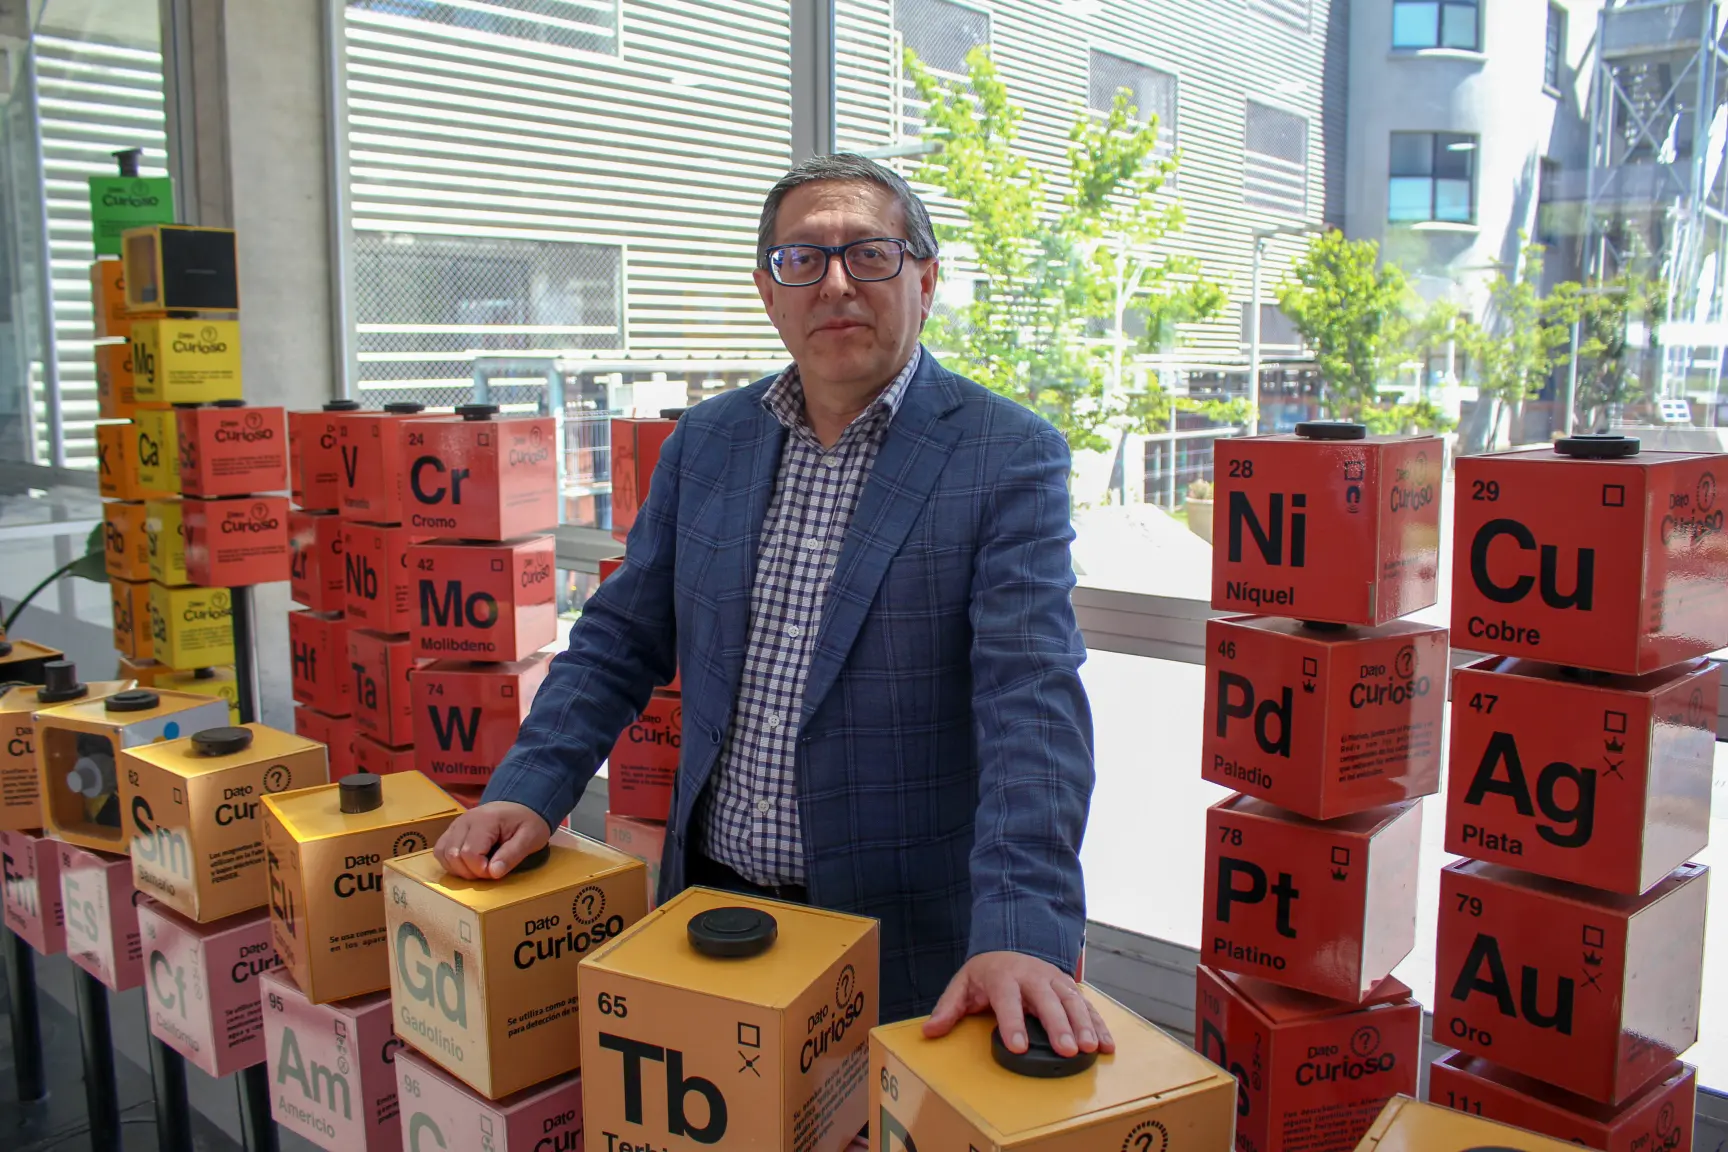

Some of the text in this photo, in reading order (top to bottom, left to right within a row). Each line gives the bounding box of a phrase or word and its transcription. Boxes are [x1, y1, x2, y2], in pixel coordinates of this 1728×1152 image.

[102, 194, 160, 208] Curioso
[172, 340, 228, 355] Curioso
[133, 342, 155, 383] Mg
[139, 432, 159, 467] Ca
[214, 427, 273, 443] Curioso
[408, 433, 425, 446] 24
[341, 445, 358, 488] V
[509, 447, 548, 466] Curioso
[1229, 460, 1254, 478] 28
[410, 455, 470, 506] Cr
[1472, 480, 1500, 501] 29
[1390, 484, 1433, 513] Curioso
[1669, 493, 1690, 509] Dato
[221, 517, 279, 535] Curioso
[412, 514, 457, 529] Cromo
[1228, 491, 1307, 568] Ni
[345, 552, 377, 600] Nb
[417, 558, 434, 571] 42
[1470, 518, 1595, 612] Cu
[419, 579, 499, 629] Mo
[1226, 581, 1295, 607] Níquel
[421, 636, 496, 653] Molibdeno
[1468, 616, 1540, 645] Cobre
[292, 638, 316, 684] Hf
[1218, 640, 1236, 660] 46
[351, 661, 377, 711] Ta
[1360, 664, 1386, 679] Dato
[426, 683, 444, 696] 74
[1349, 675, 1431, 709] Curioso
[1469, 693, 1499, 715] 47
[427, 705, 482, 752] W
[1216, 670, 1294, 759] Pd
[628, 724, 681, 748] Curio
[128, 769, 140, 787] 62
[1214, 754, 1272, 790] Paladio
[223, 783, 253, 800] Dato
[1464, 731, 1597, 849] Ag
[131, 795, 190, 880] Sm
[612, 828, 632, 844] 109
[1218, 826, 1243, 846] 78
[1462, 824, 1523, 857] Plata
[344, 853, 381, 870] Dato
[137, 864, 176, 897] Samario
[65, 876, 98, 943] Es
[392, 885, 408, 908] 64
[1216, 855, 1299, 939] Pt
[1456, 893, 1483, 918] 79
[525, 914, 560, 936] Dato
[239, 940, 268, 958] Dato
[362, 936, 386, 946] apara
[513, 913, 625, 970] Curioso
[1213, 937, 1287, 970] Platino
[150, 949, 187, 1020] Cf
[396, 921, 468, 1030] Gd
[1450, 932, 1575, 1036] Au
[268, 992, 284, 1013] 95
[507, 1017, 518, 1027] Se
[519, 1008, 545, 1022] utiliza
[545, 1000, 566, 1013] como
[597, 992, 628, 1018] 65
[508, 1025, 525, 1038] para
[561, 1008, 571, 1017] de
[800, 991, 864, 1074] Curioso
[807, 1003, 829, 1035] Dato
[1450, 1017, 1493, 1047] Oro
[400, 1006, 465, 1063] Gadolinio
[1308, 1044, 1339, 1060] Dato
[276, 1026, 352, 1121] Am
[880, 1065, 899, 1102] 66
[1295, 1052, 1396, 1087] Curioso
[403, 1073, 421, 1098] 96
[598, 1031, 728, 1145] Tb
[278, 1095, 336, 1139] Americio
[1447, 1091, 1483, 1116] 111
[543, 1109, 576, 1133] Dato
